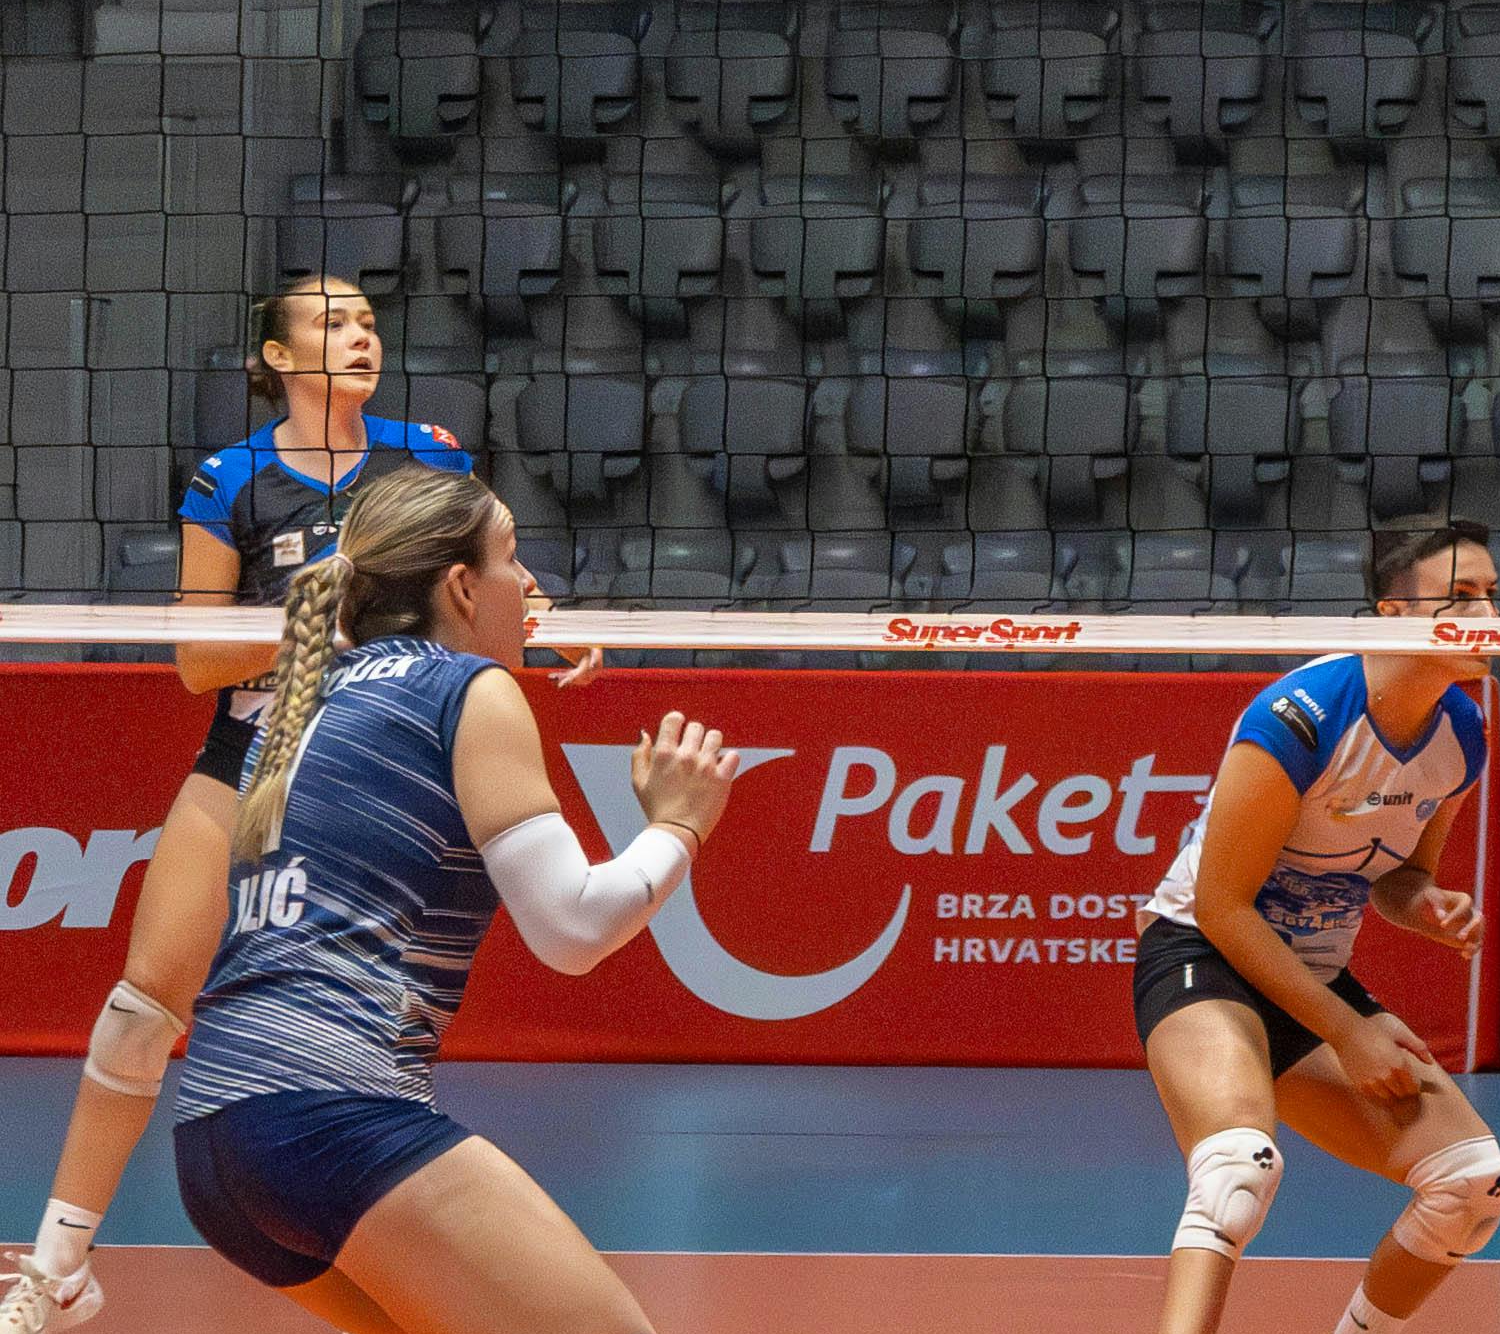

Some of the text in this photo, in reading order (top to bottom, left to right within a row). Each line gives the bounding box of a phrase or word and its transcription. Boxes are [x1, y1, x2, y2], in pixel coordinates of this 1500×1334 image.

[886, 618, 1082, 653] SuperSport
[936, 893, 1155, 919] BRZA DOST
[934, 937, 1137, 964] HRVATSKE
